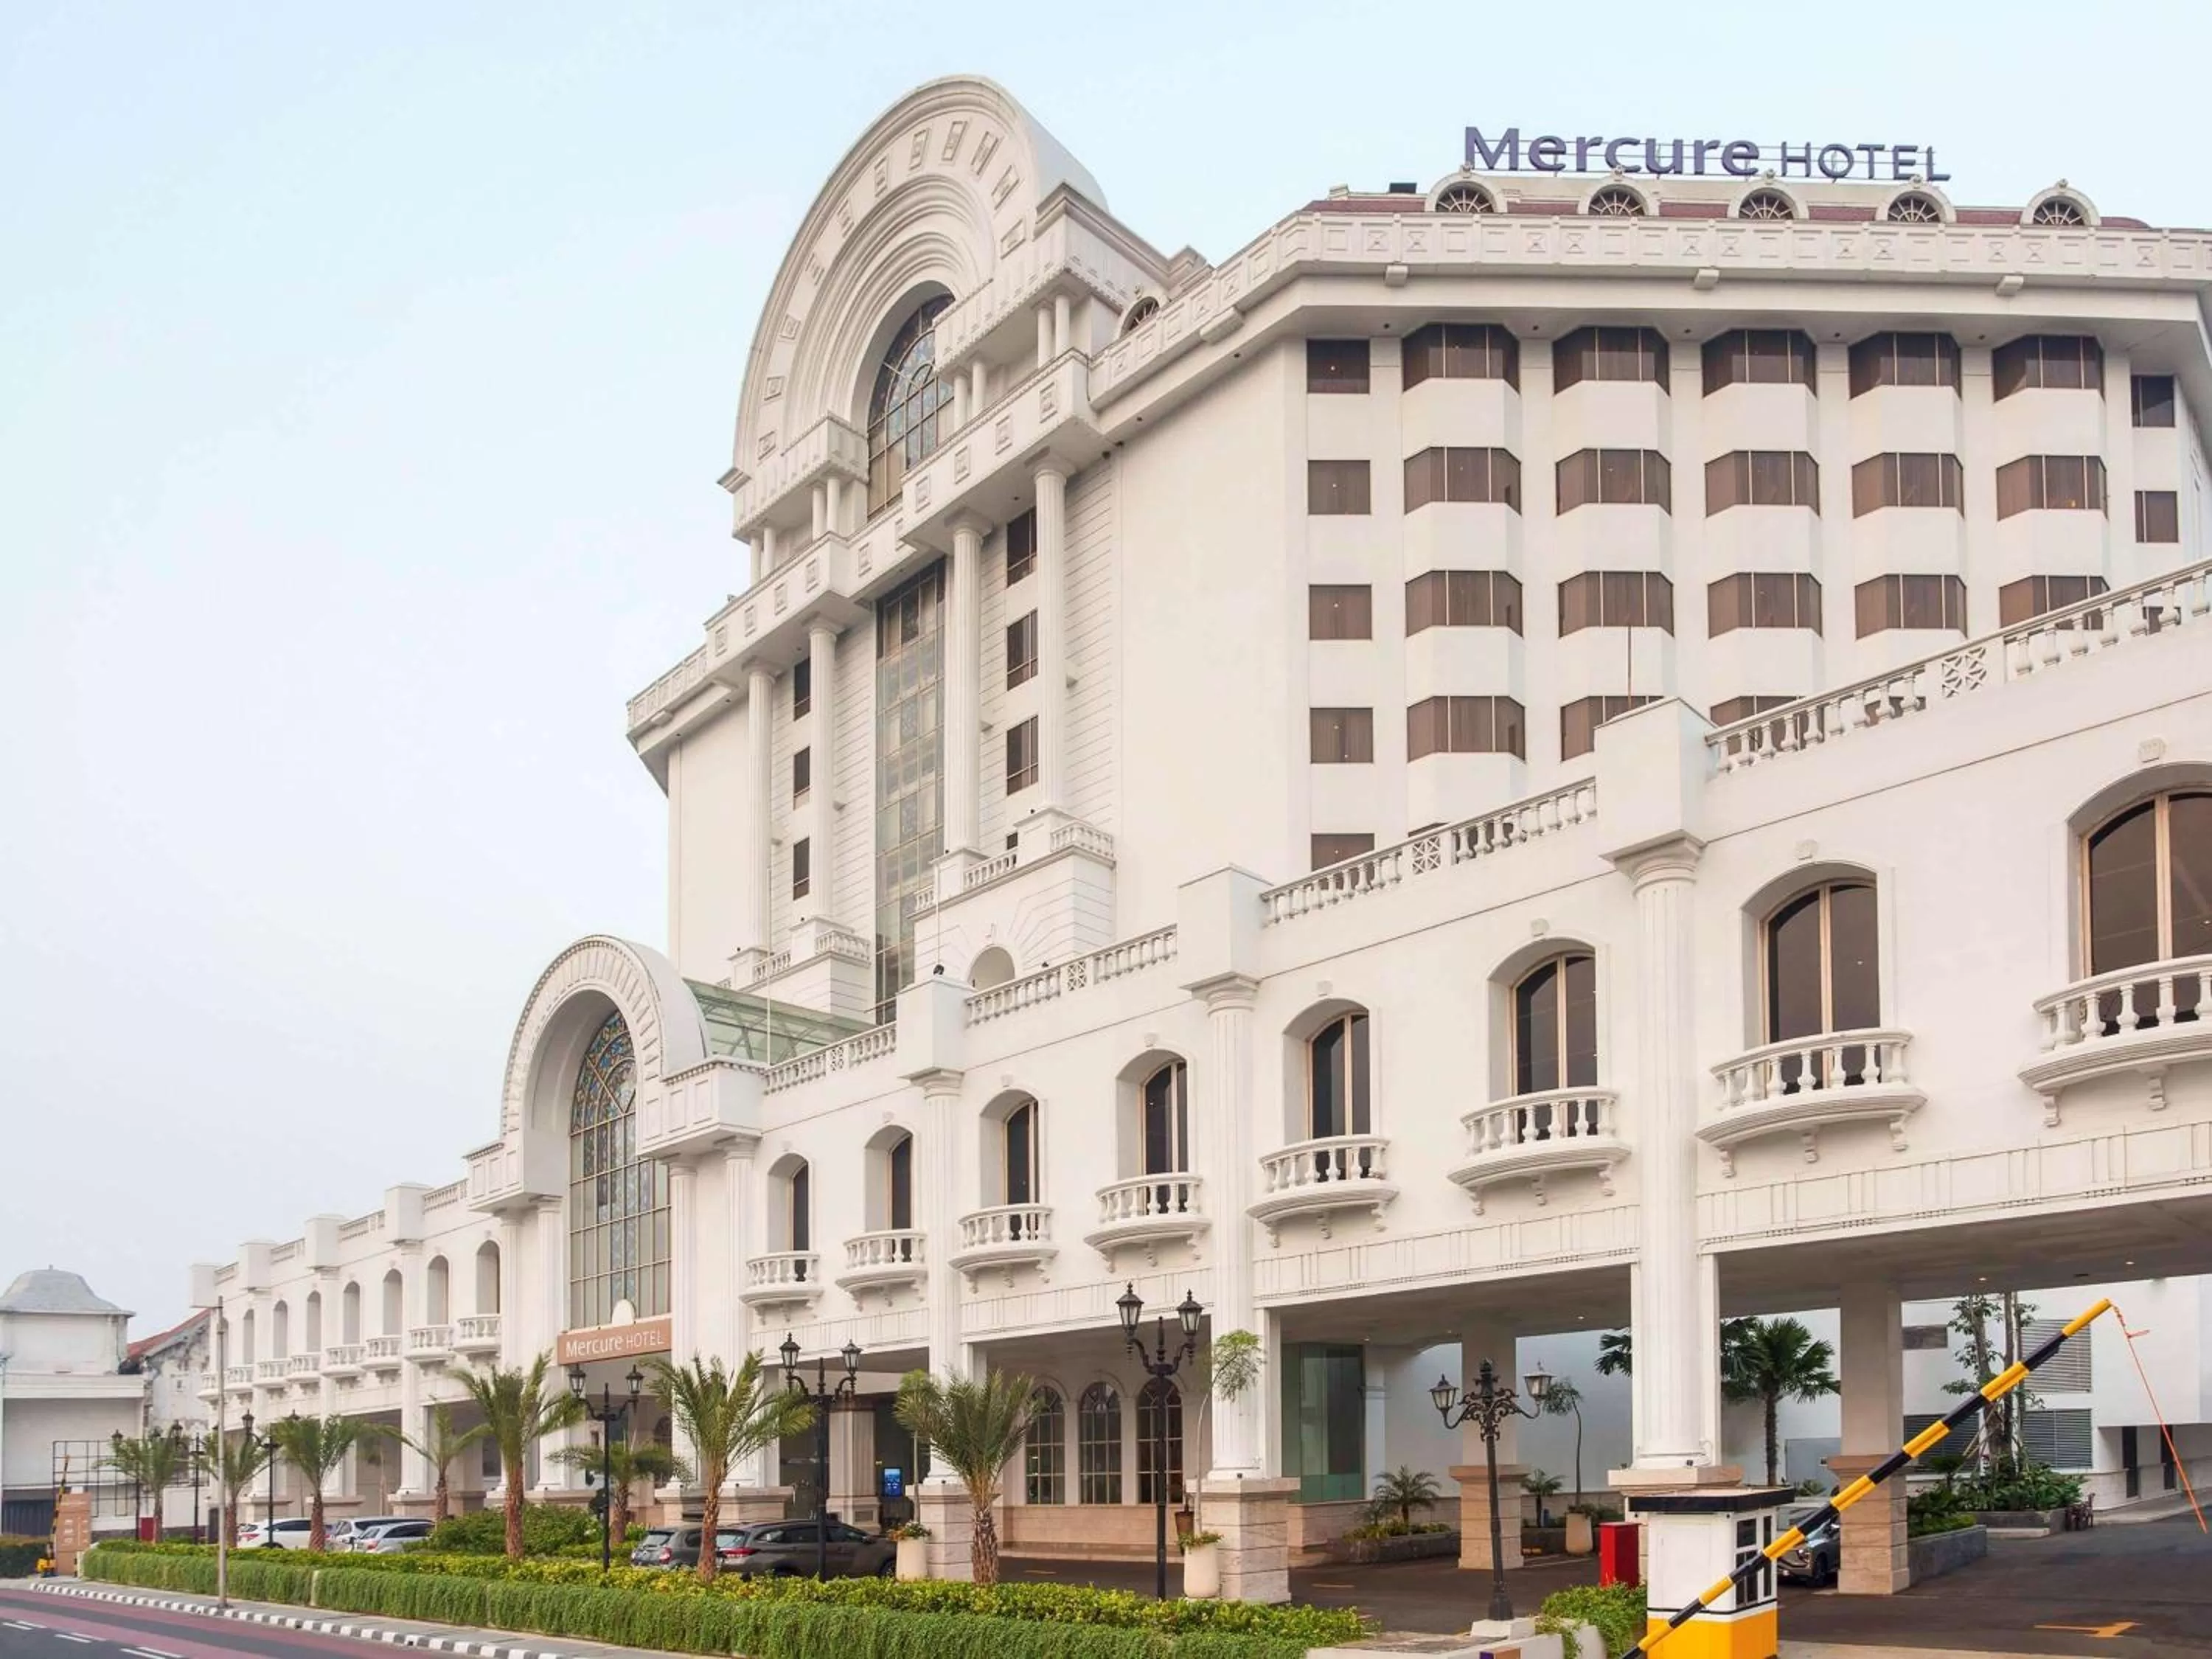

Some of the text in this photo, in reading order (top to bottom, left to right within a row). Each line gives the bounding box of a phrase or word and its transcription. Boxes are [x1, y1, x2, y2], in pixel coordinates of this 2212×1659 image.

[1465, 126, 1951, 181] Mercure HOTEL
[566, 1326, 664, 1357] Mercure HOTEL
